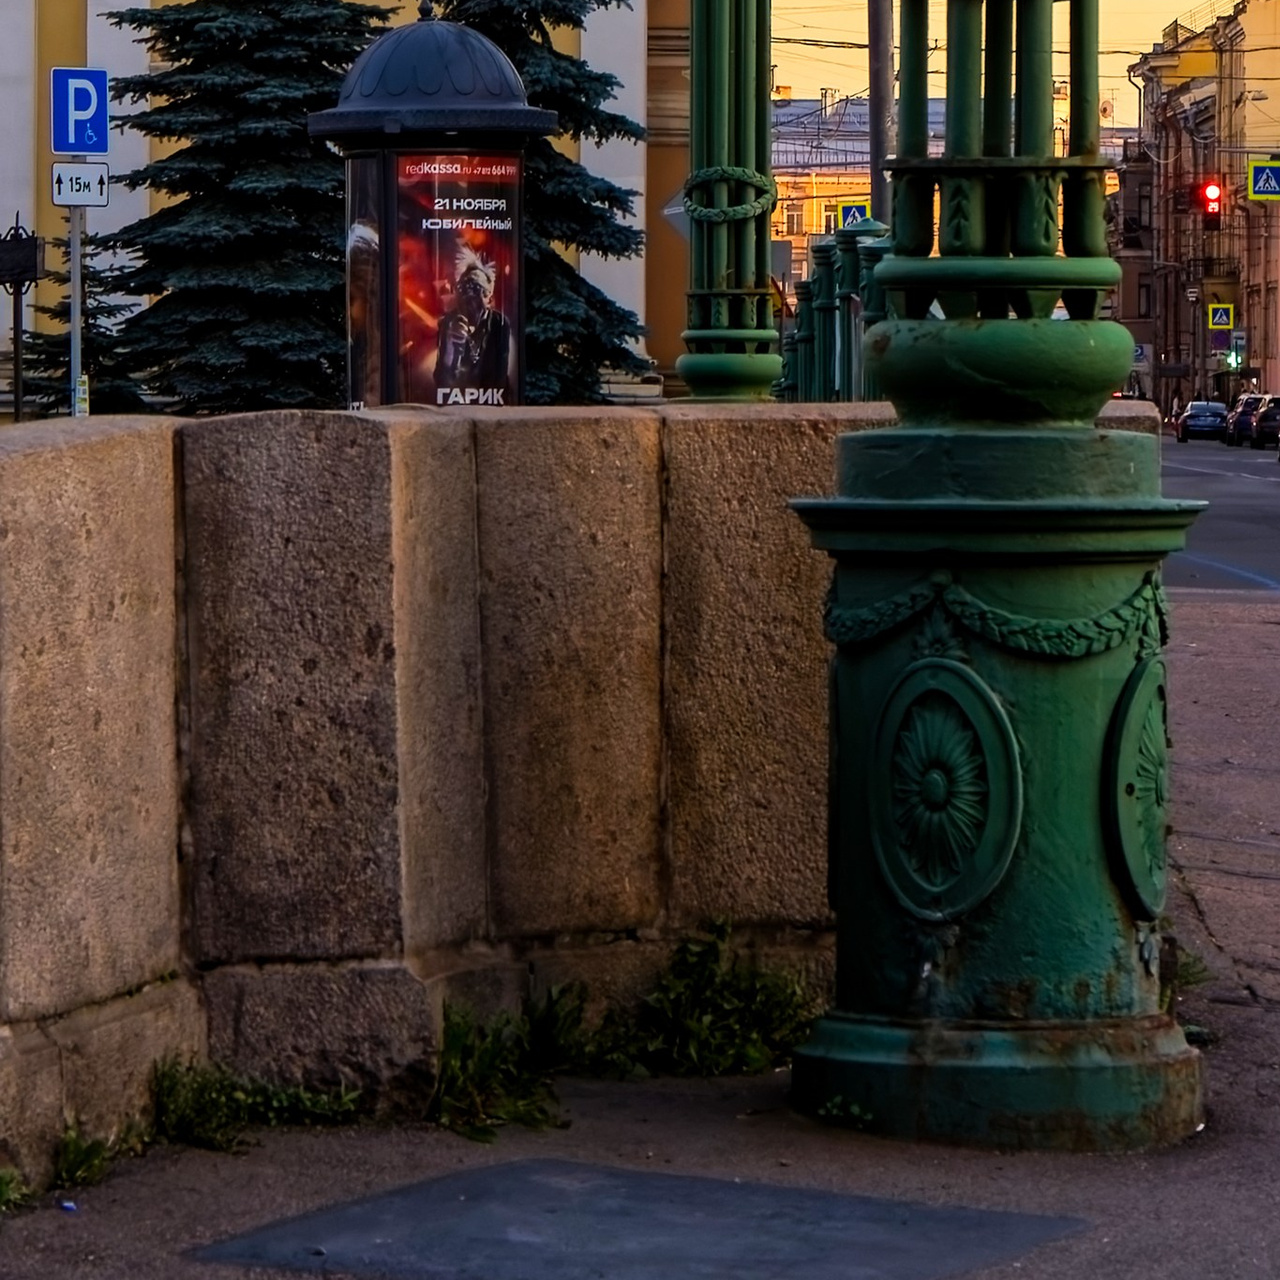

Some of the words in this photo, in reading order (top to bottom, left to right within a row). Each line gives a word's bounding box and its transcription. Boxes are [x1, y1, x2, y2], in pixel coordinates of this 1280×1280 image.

[68, 78, 98, 143] P
[406, 162, 471, 174] redkassa.ru
[69, 176, 91, 193] 15м
[434, 199, 450, 210] 21
[453, 199, 507, 211] НОЯБРЯ
[422, 217, 512, 230] ЮБИЛЕЙНЫЙ
[436, 388, 504, 405] ГАРИК
